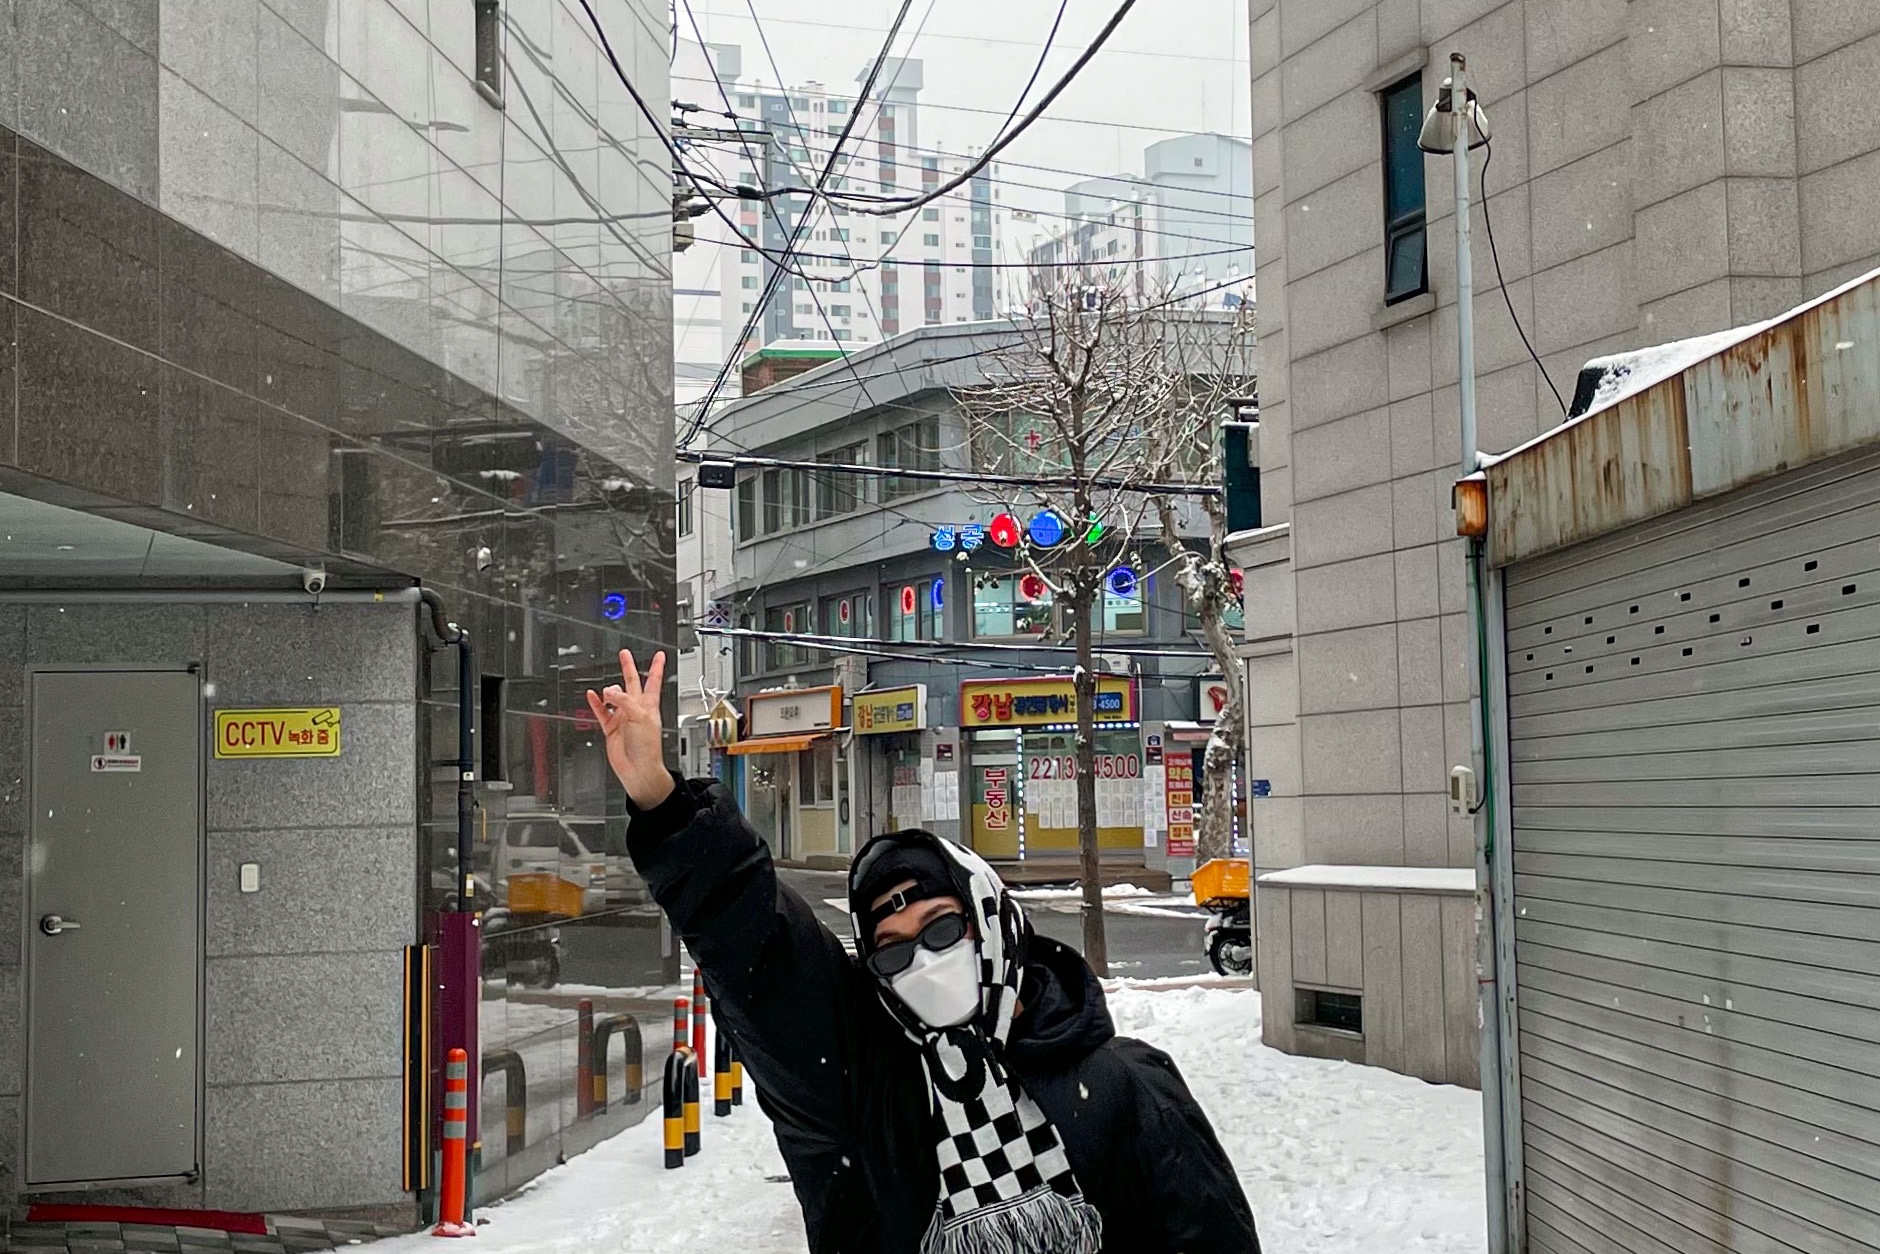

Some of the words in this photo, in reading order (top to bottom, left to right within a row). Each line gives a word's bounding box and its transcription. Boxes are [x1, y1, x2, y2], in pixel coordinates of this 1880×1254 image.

[971, 692, 1013, 721] 강남
[226, 721, 286, 747] CCTV
[288, 729, 314, 746] 녹화
[317, 729, 330, 745] 중
[984, 767, 1009, 830] 부동산
